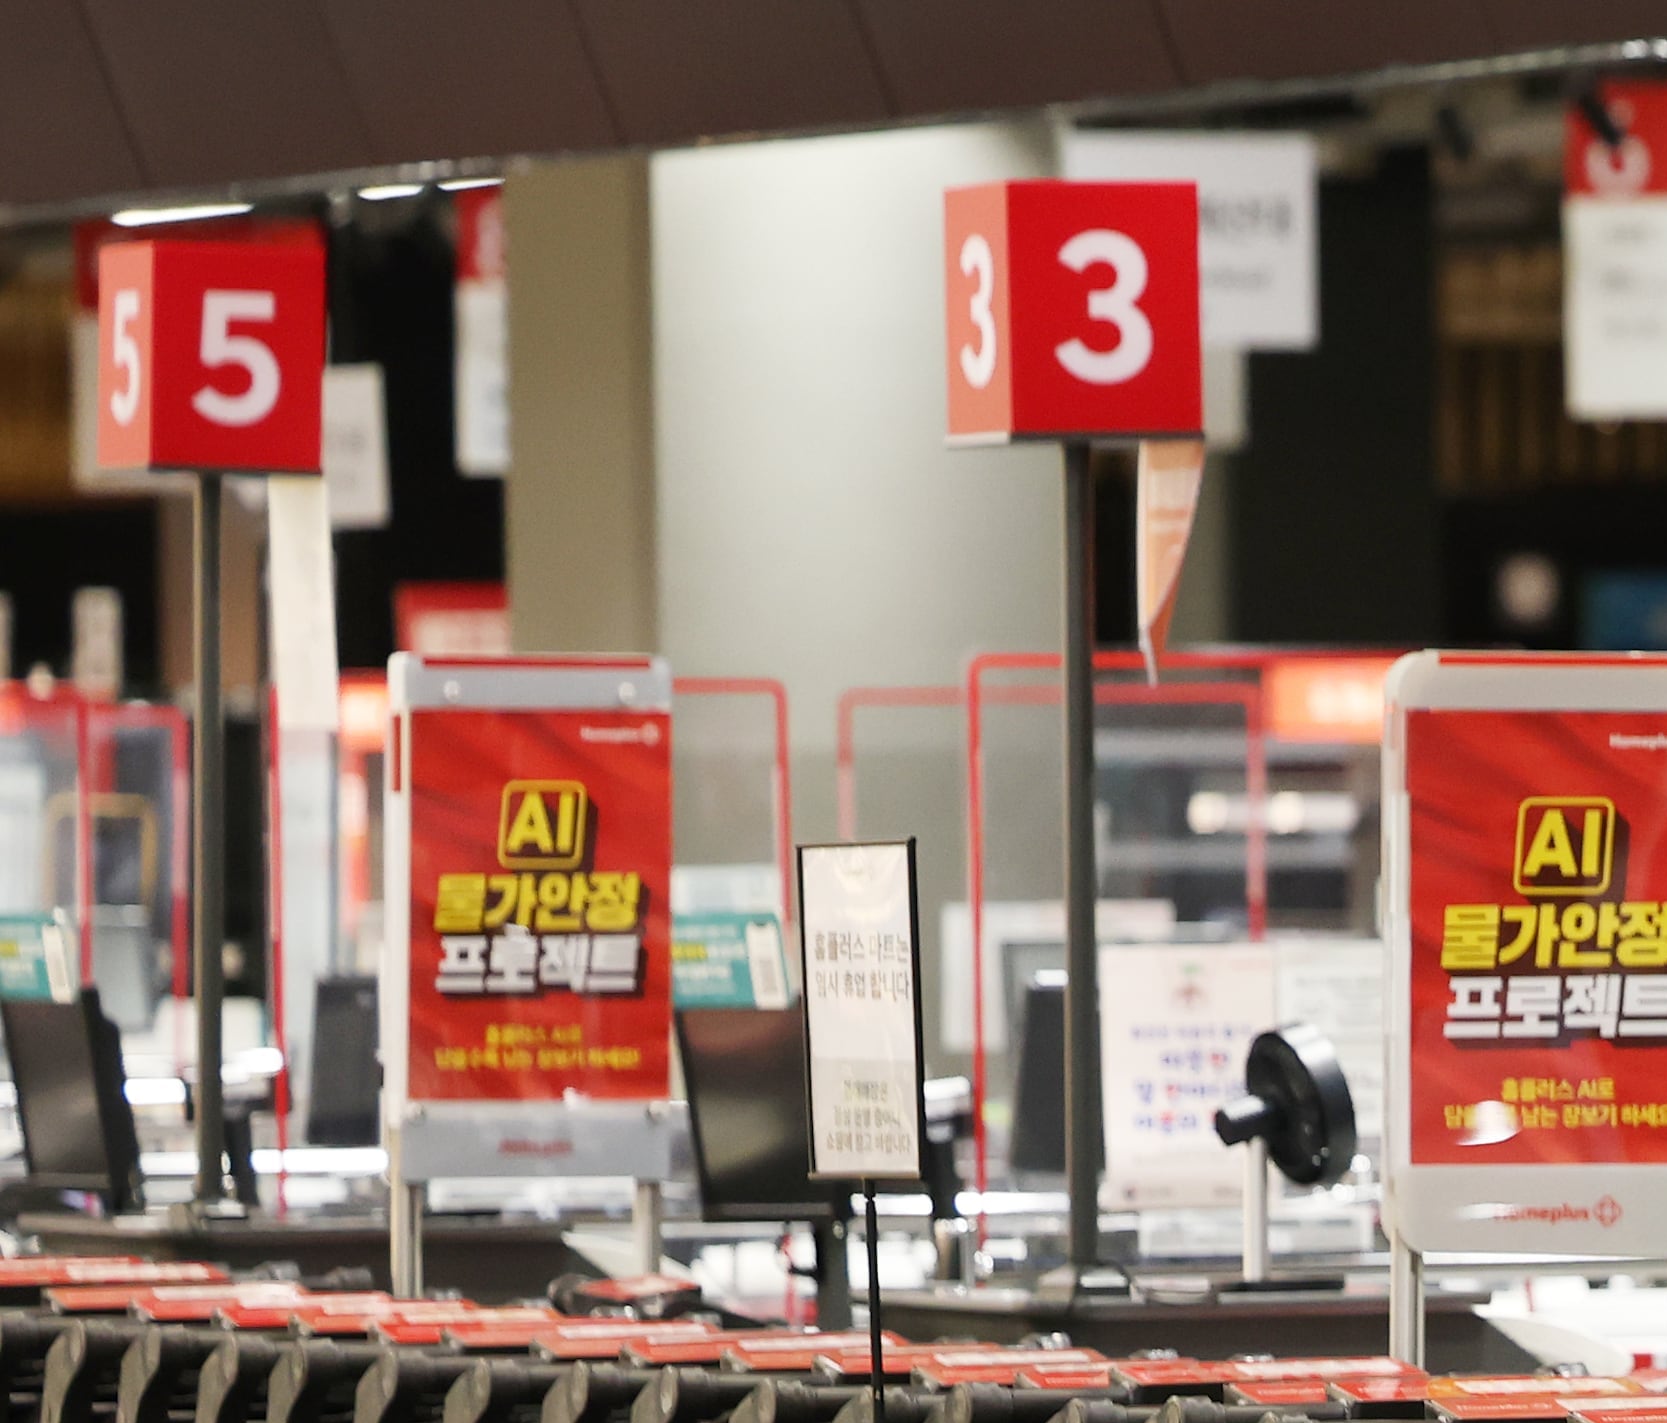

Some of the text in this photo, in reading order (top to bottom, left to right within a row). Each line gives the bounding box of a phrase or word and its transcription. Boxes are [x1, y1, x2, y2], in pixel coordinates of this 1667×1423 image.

[960, 235, 996, 389] 3
[1055, 229, 1154, 385] 3
[110, 289, 141, 426] 5
[192, 290, 281, 427] 5
[506, 791, 575, 854] AI
[1523, 809, 1603, 877] AI
[434, 872, 640, 931] 물가안정
[435, 934, 639, 993] 프로젝트
[815, 930, 865, 963] 홈플러스
[1494, 1202, 1589, 1225] omeplus
